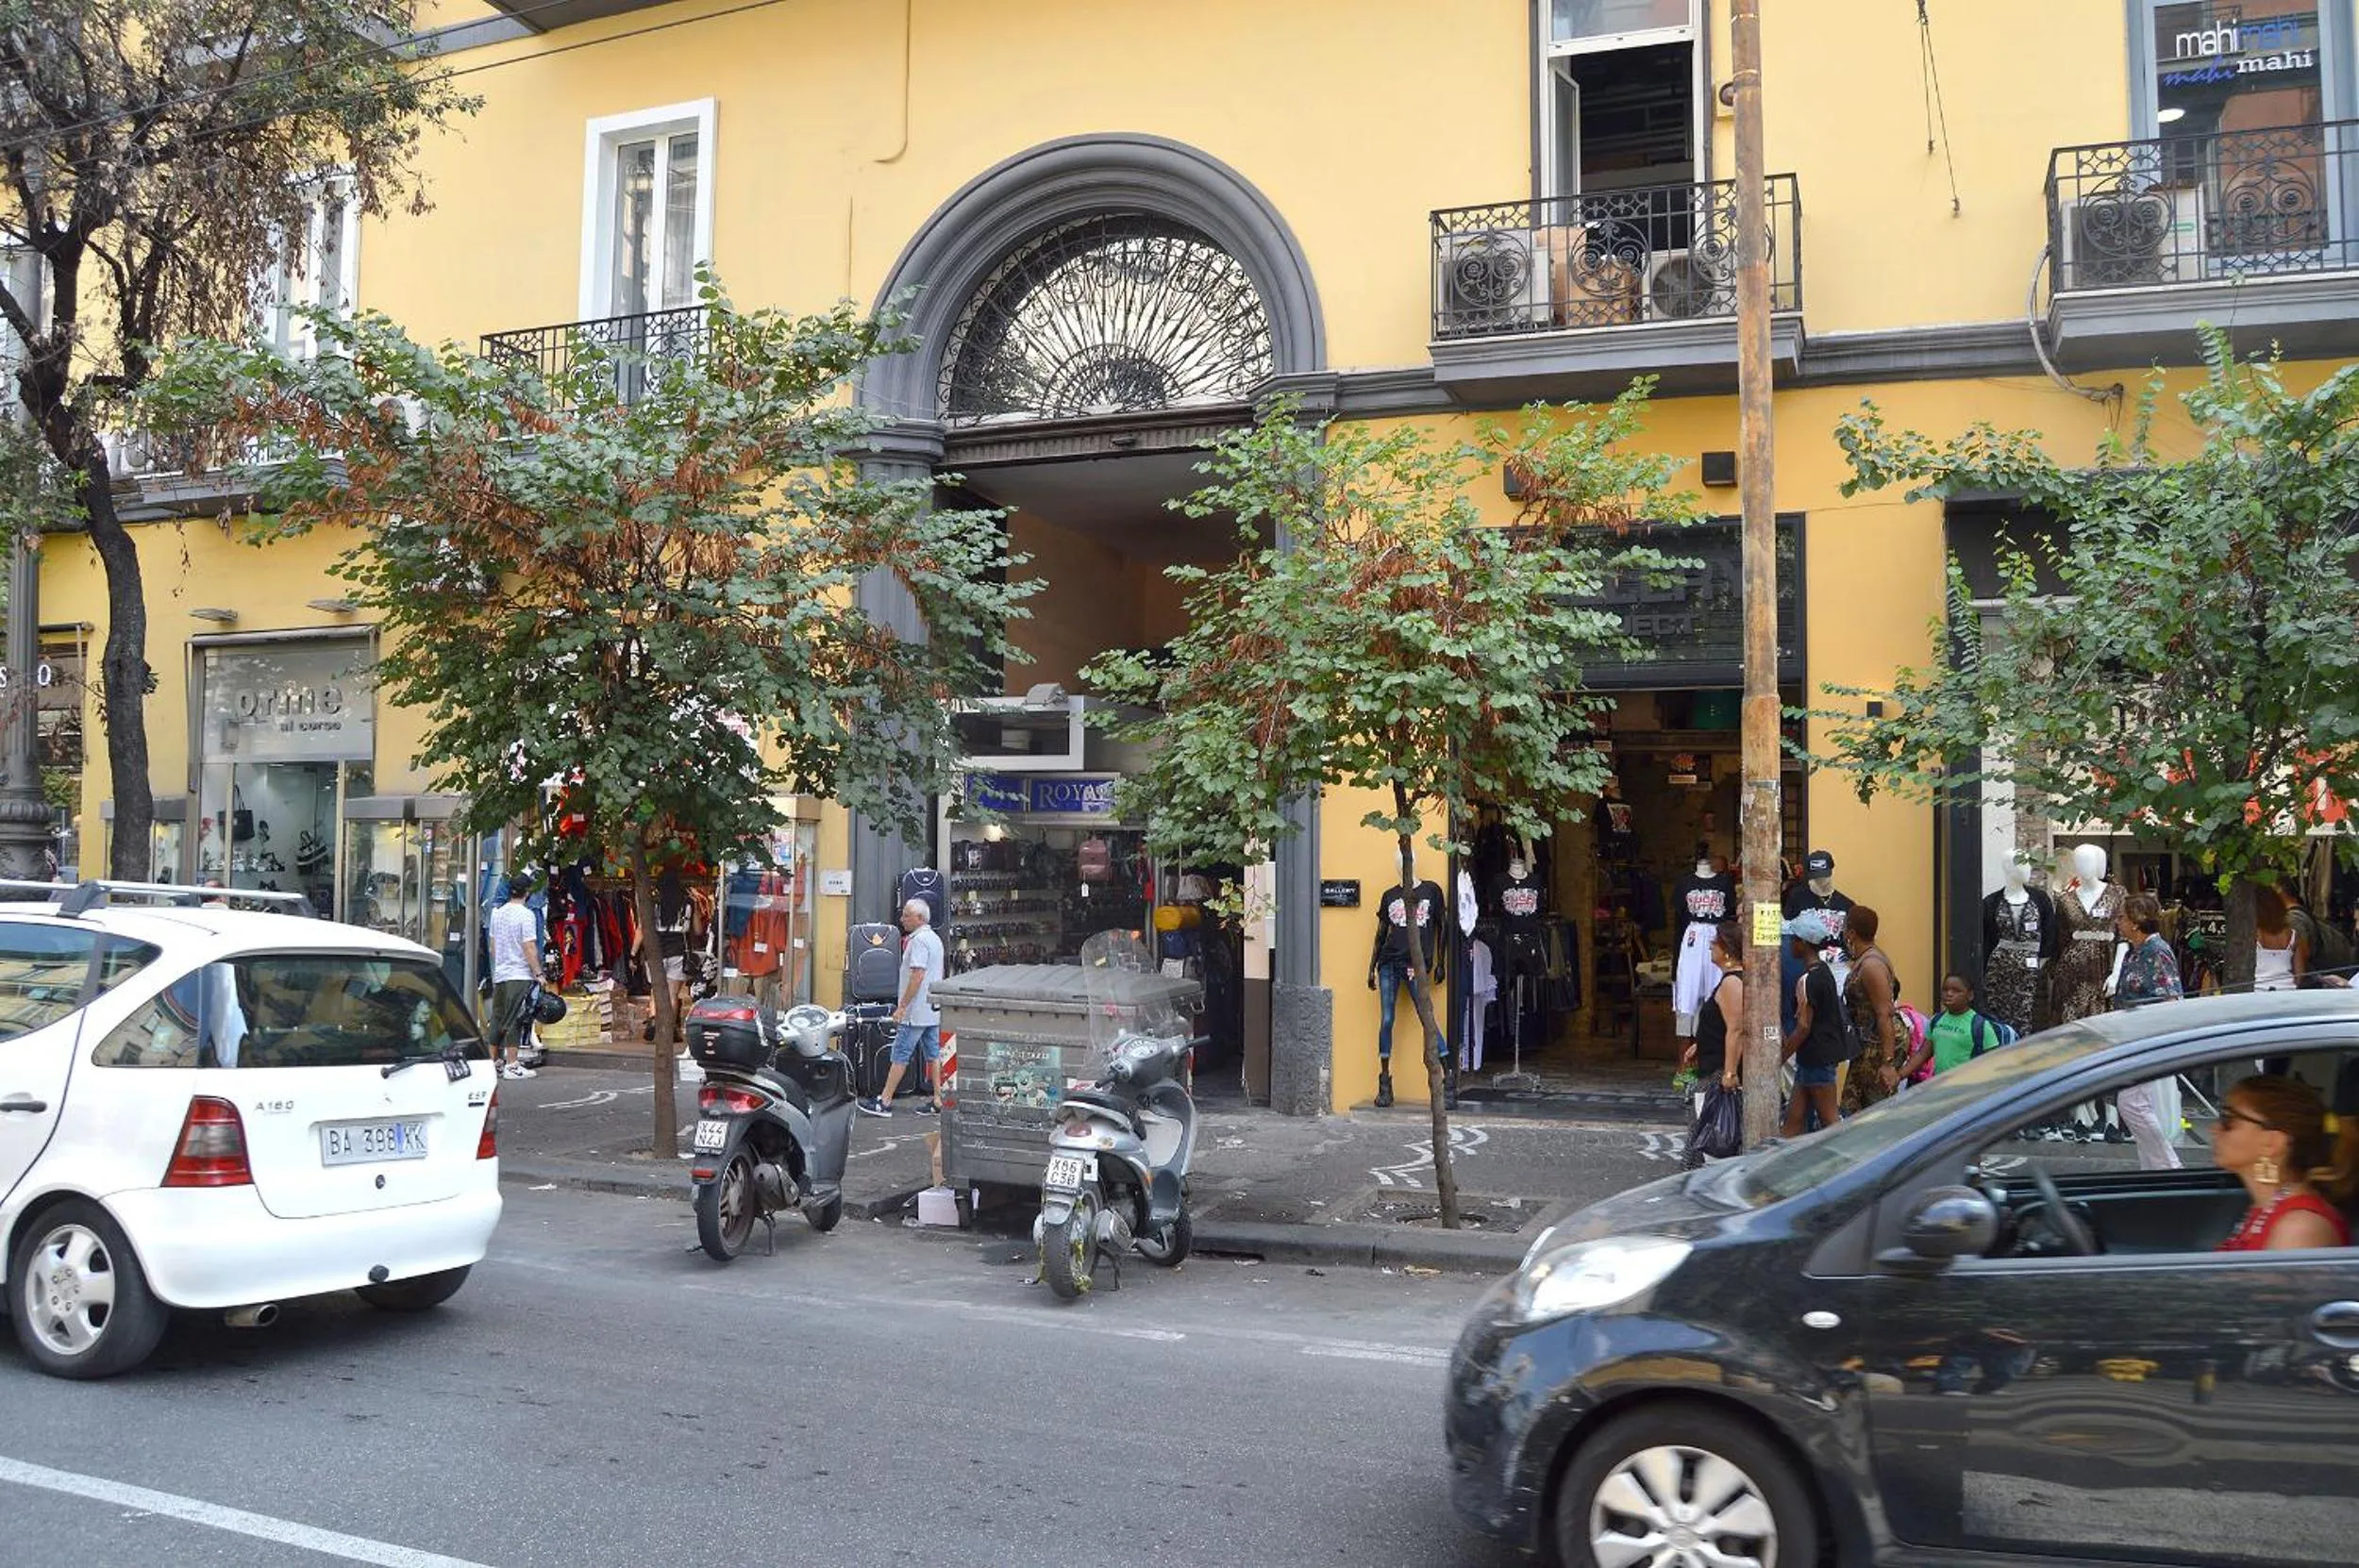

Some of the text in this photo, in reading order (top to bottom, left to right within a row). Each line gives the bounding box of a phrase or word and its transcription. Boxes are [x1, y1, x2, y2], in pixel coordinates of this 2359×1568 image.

[2176, 19, 2237, 58] mahi
[2236, 49, 2314, 74] mahi
[329, 1129, 353, 1156] BA
[362, 1127, 396, 1153] 398
